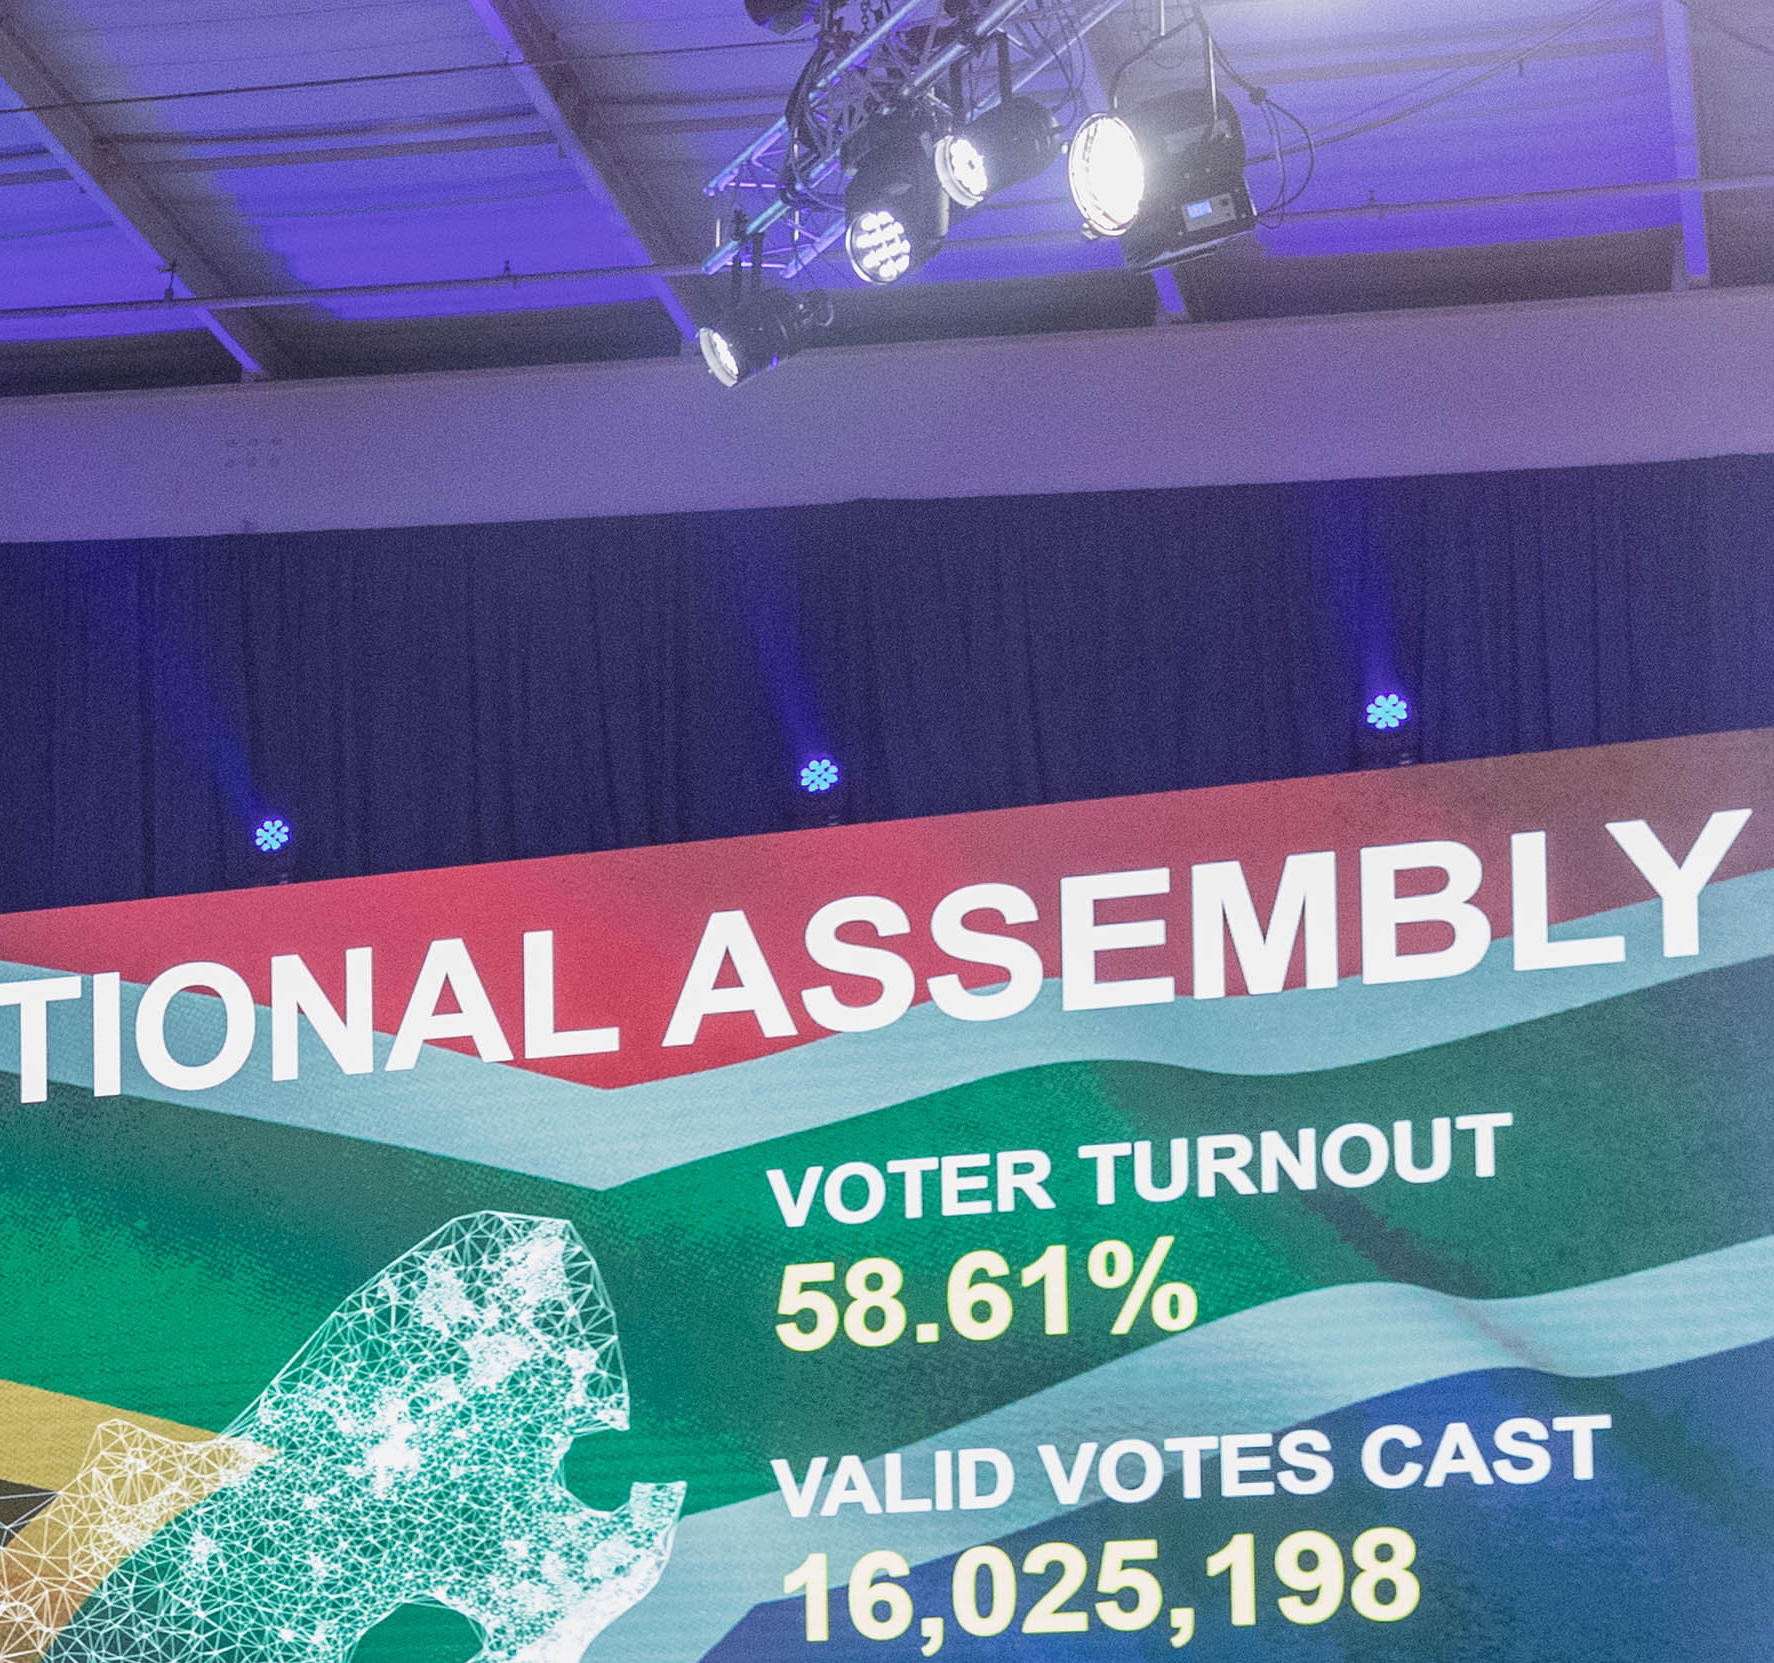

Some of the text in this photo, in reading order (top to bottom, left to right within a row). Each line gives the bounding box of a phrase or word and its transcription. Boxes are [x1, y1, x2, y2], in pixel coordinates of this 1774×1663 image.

[662, 809, 1752, 1046] ASSEMBLY
[766, 1112, 1513, 1227] VOTER TURNOUT
[776, 1236, 1197, 1351] 58.61%
[771, 1415, 1611, 1518] VALID VOTES CAST
[782, 1527, 1422, 1656] 16,025,198
